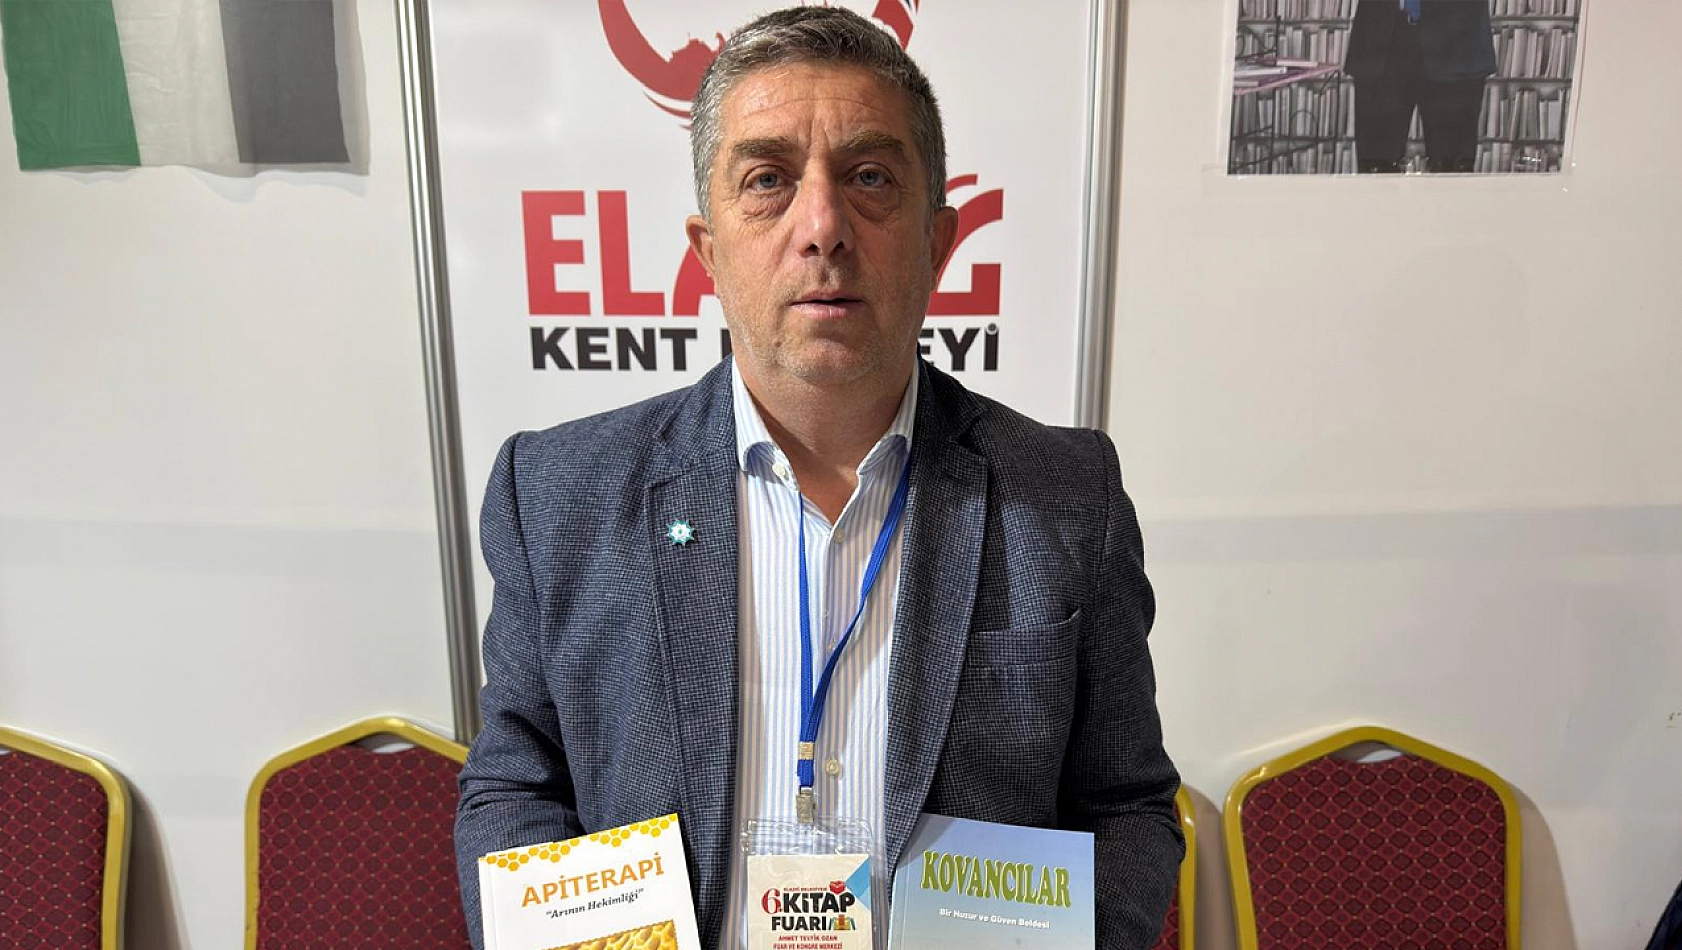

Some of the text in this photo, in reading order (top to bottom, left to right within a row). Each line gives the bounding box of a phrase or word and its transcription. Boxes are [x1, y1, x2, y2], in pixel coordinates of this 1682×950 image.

[530, 327, 697, 372] KENT
[521, 851, 665, 908] APİTERAPİ
[921, 850, 1071, 908] KOVANCILAR
[783, 892, 856, 913] KİTAP
[940, 908, 1050, 929] Bir Huzur ve Güven Beldesi
[772, 916, 827, 931] FUARI
